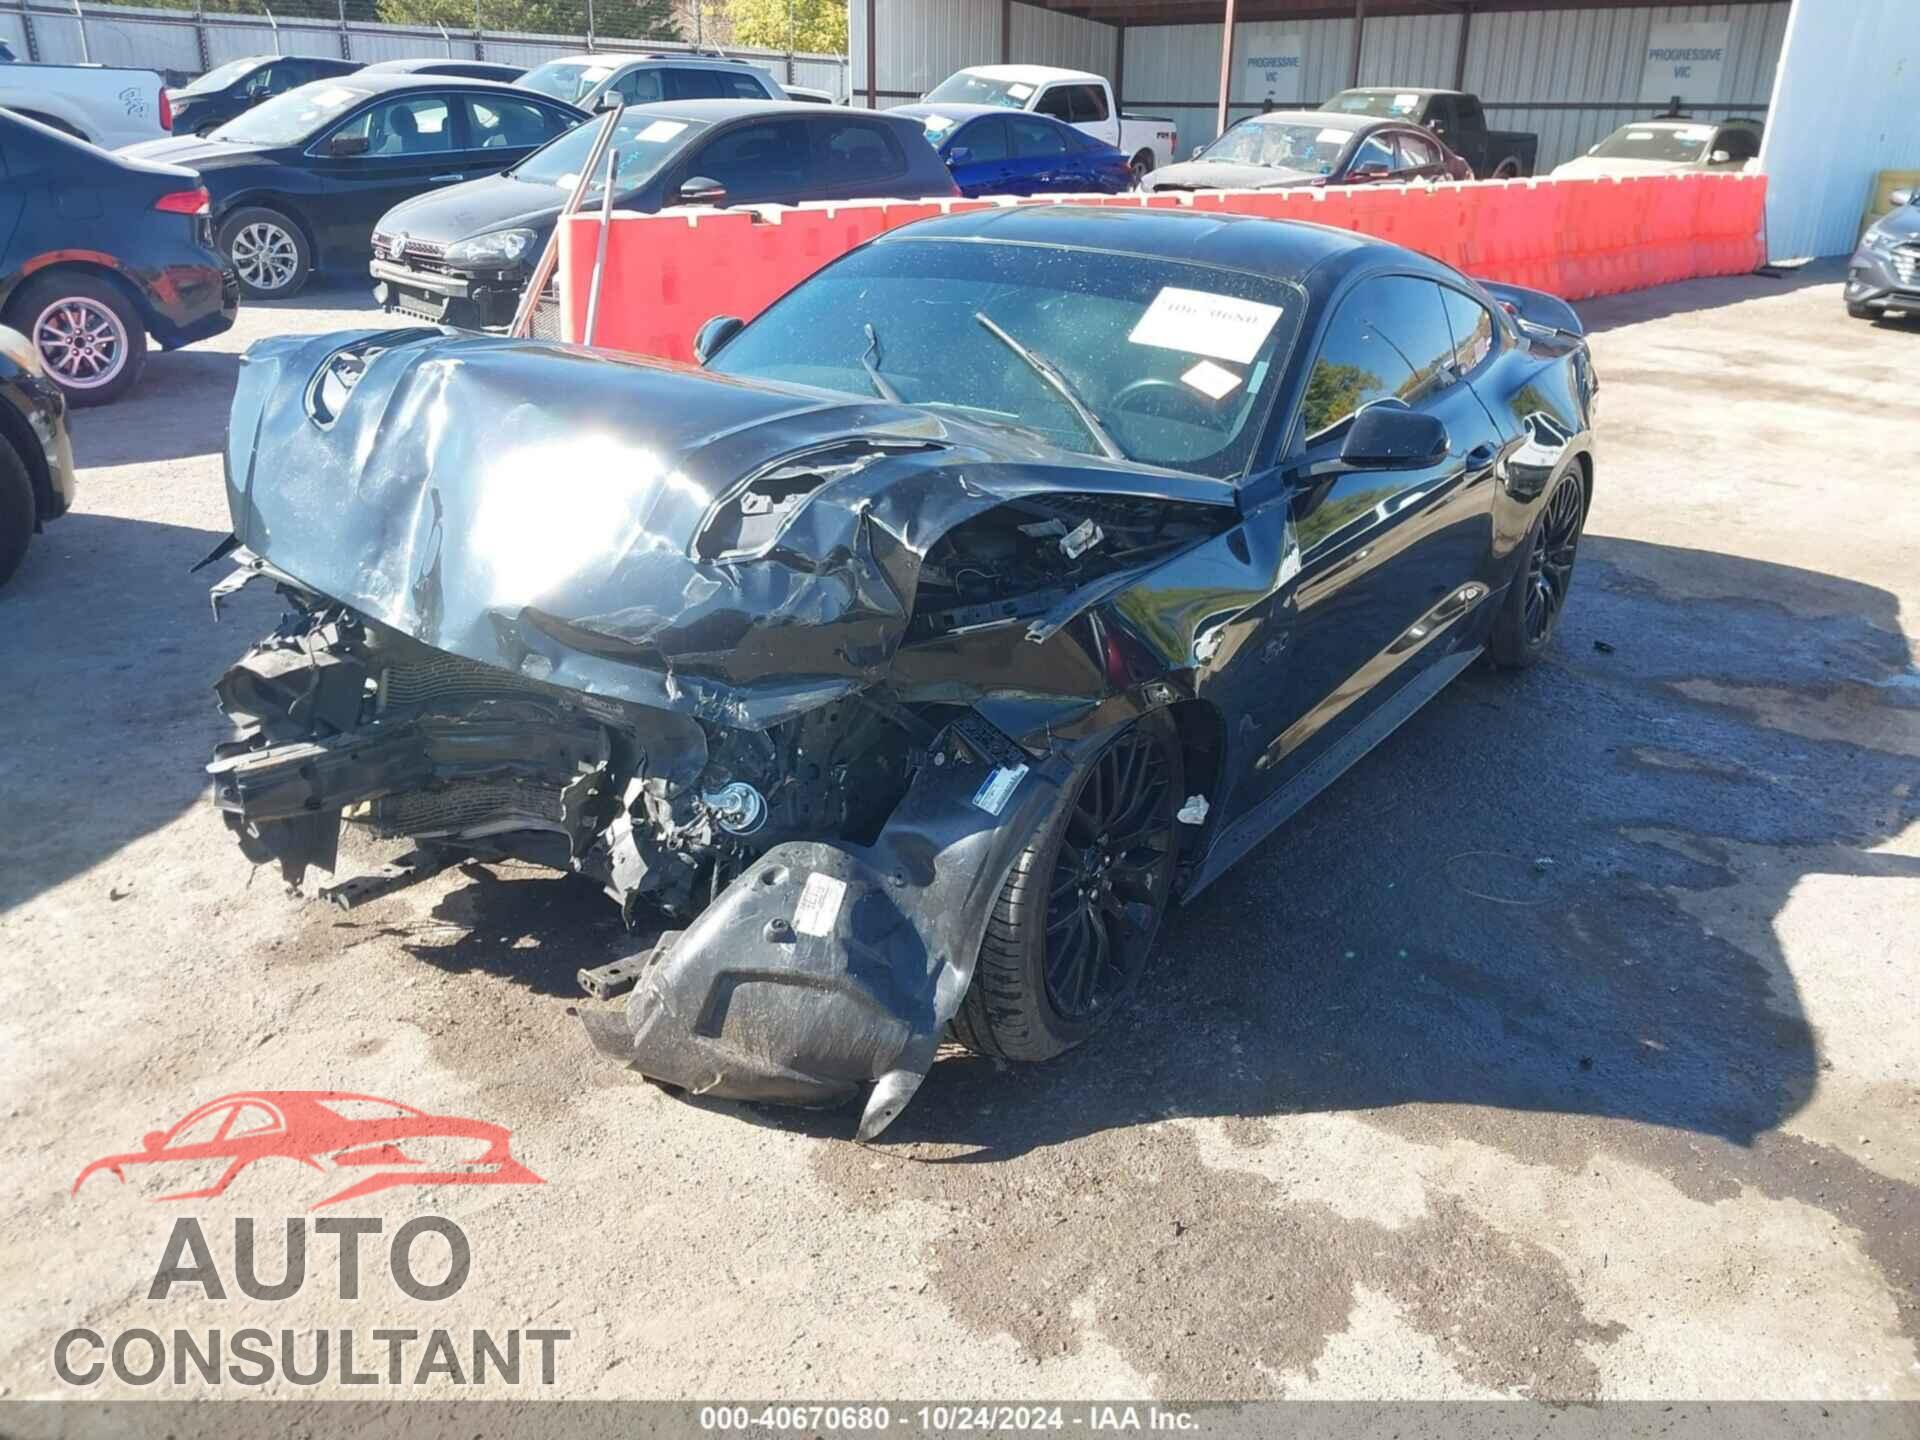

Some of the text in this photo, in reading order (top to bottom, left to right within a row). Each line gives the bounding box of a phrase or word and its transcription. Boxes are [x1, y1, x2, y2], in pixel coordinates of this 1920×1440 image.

[1648, 48, 1723, 61] PROGRESSIVE
[1247, 56, 1299, 68] PROGRESSIVE
[1674, 65, 1691, 78] VIC
